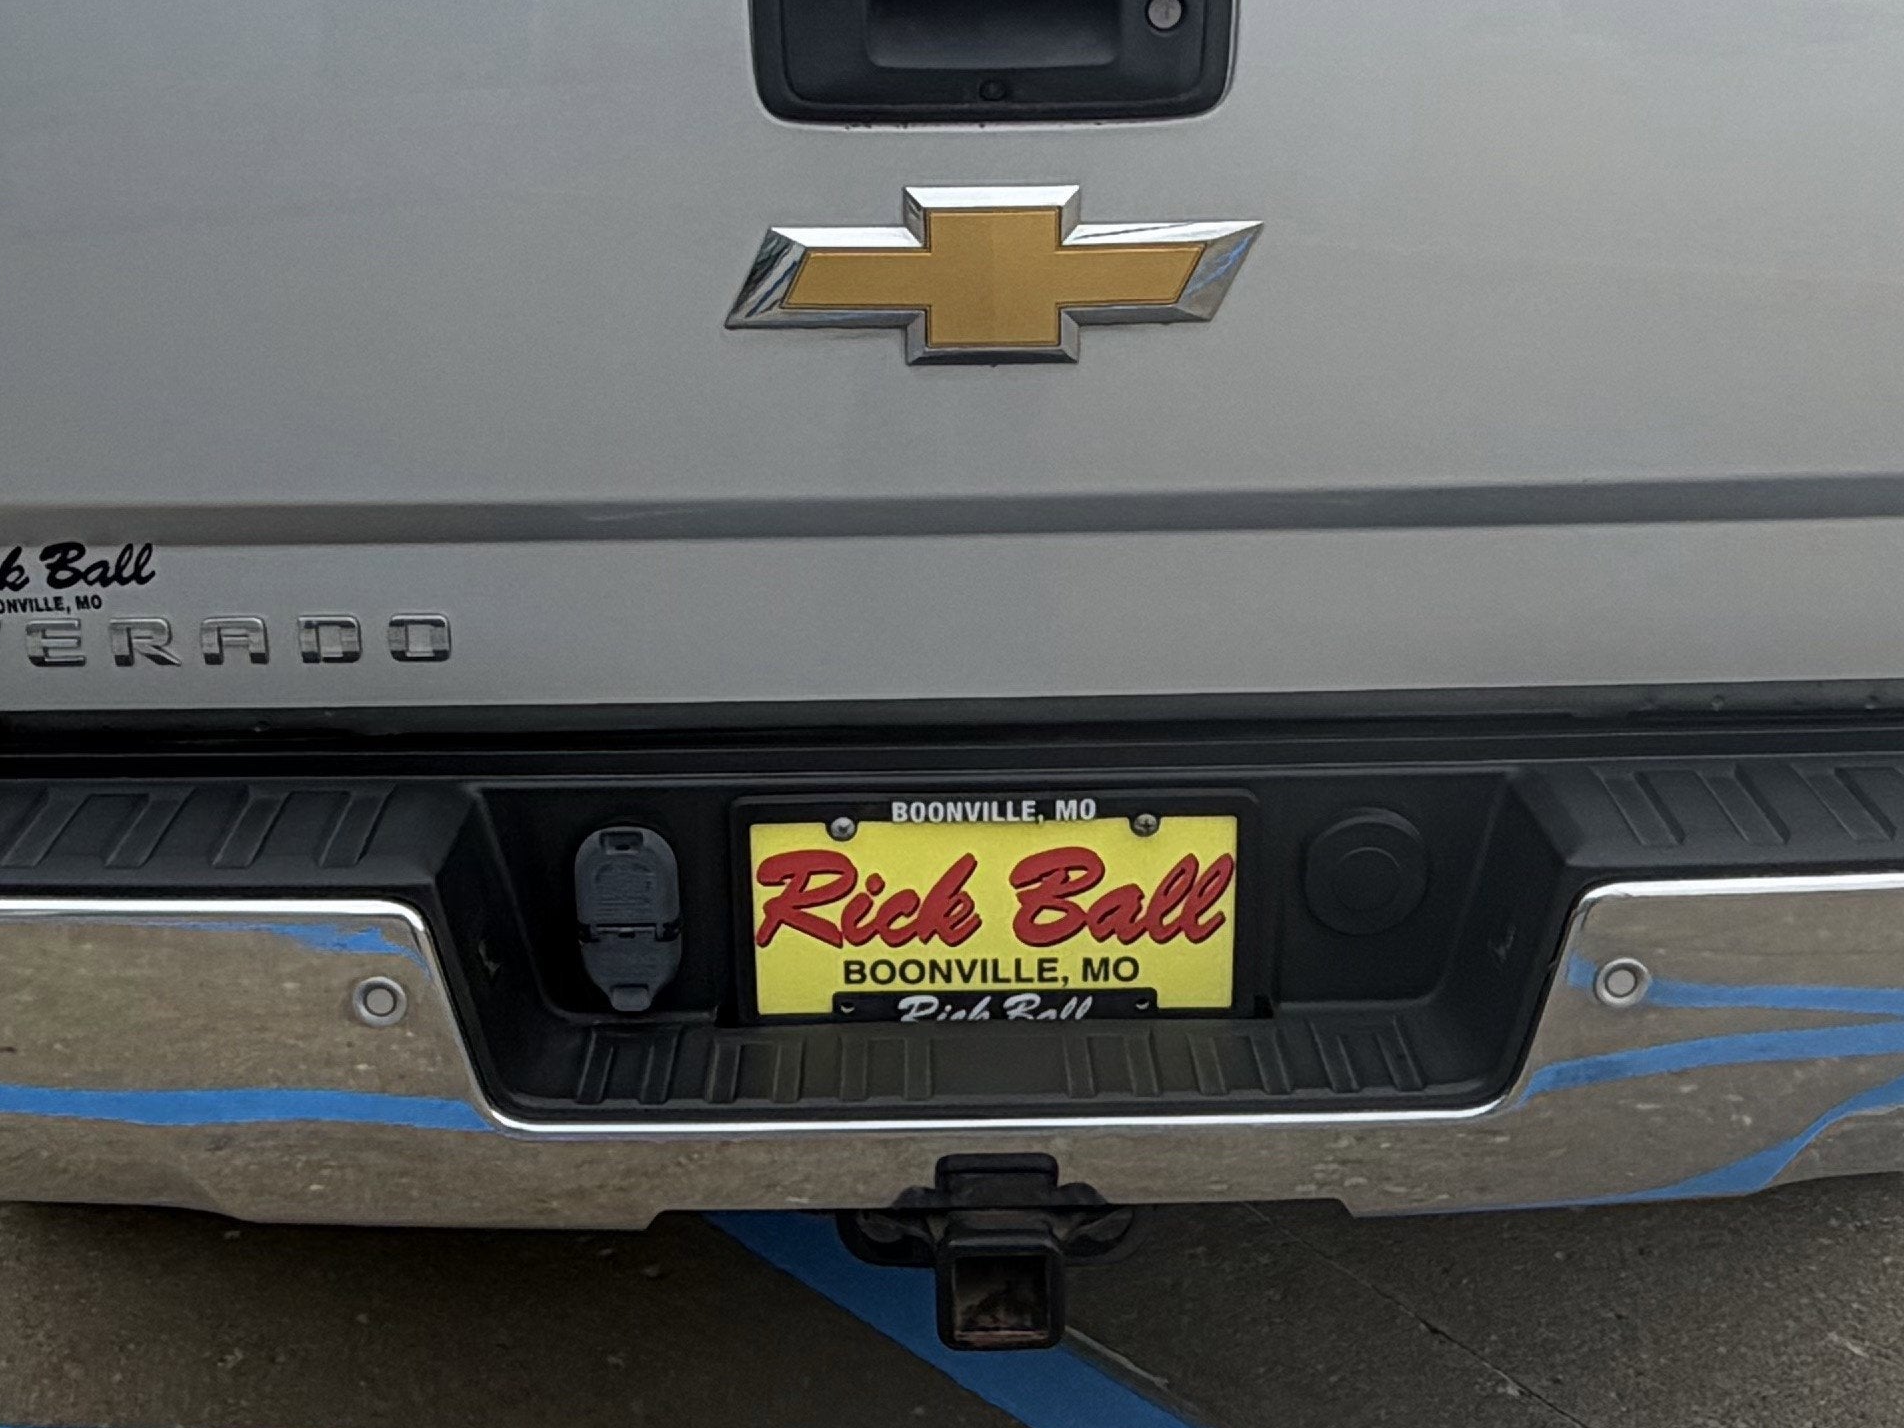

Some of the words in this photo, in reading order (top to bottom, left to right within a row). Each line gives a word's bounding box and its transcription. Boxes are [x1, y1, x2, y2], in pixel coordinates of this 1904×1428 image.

[39, 541, 156, 590] Ball
[75, 594, 103, 610] MO
[891, 799, 1045, 825] BOONVILLE,
[1054, 798, 1097, 821] MO
[755, 849, 983, 949] Rick
[1009, 846, 1235, 948] Ball
[843, 958, 1070, 988] BOONVILLE,
[1081, 956, 1140, 983] MO
